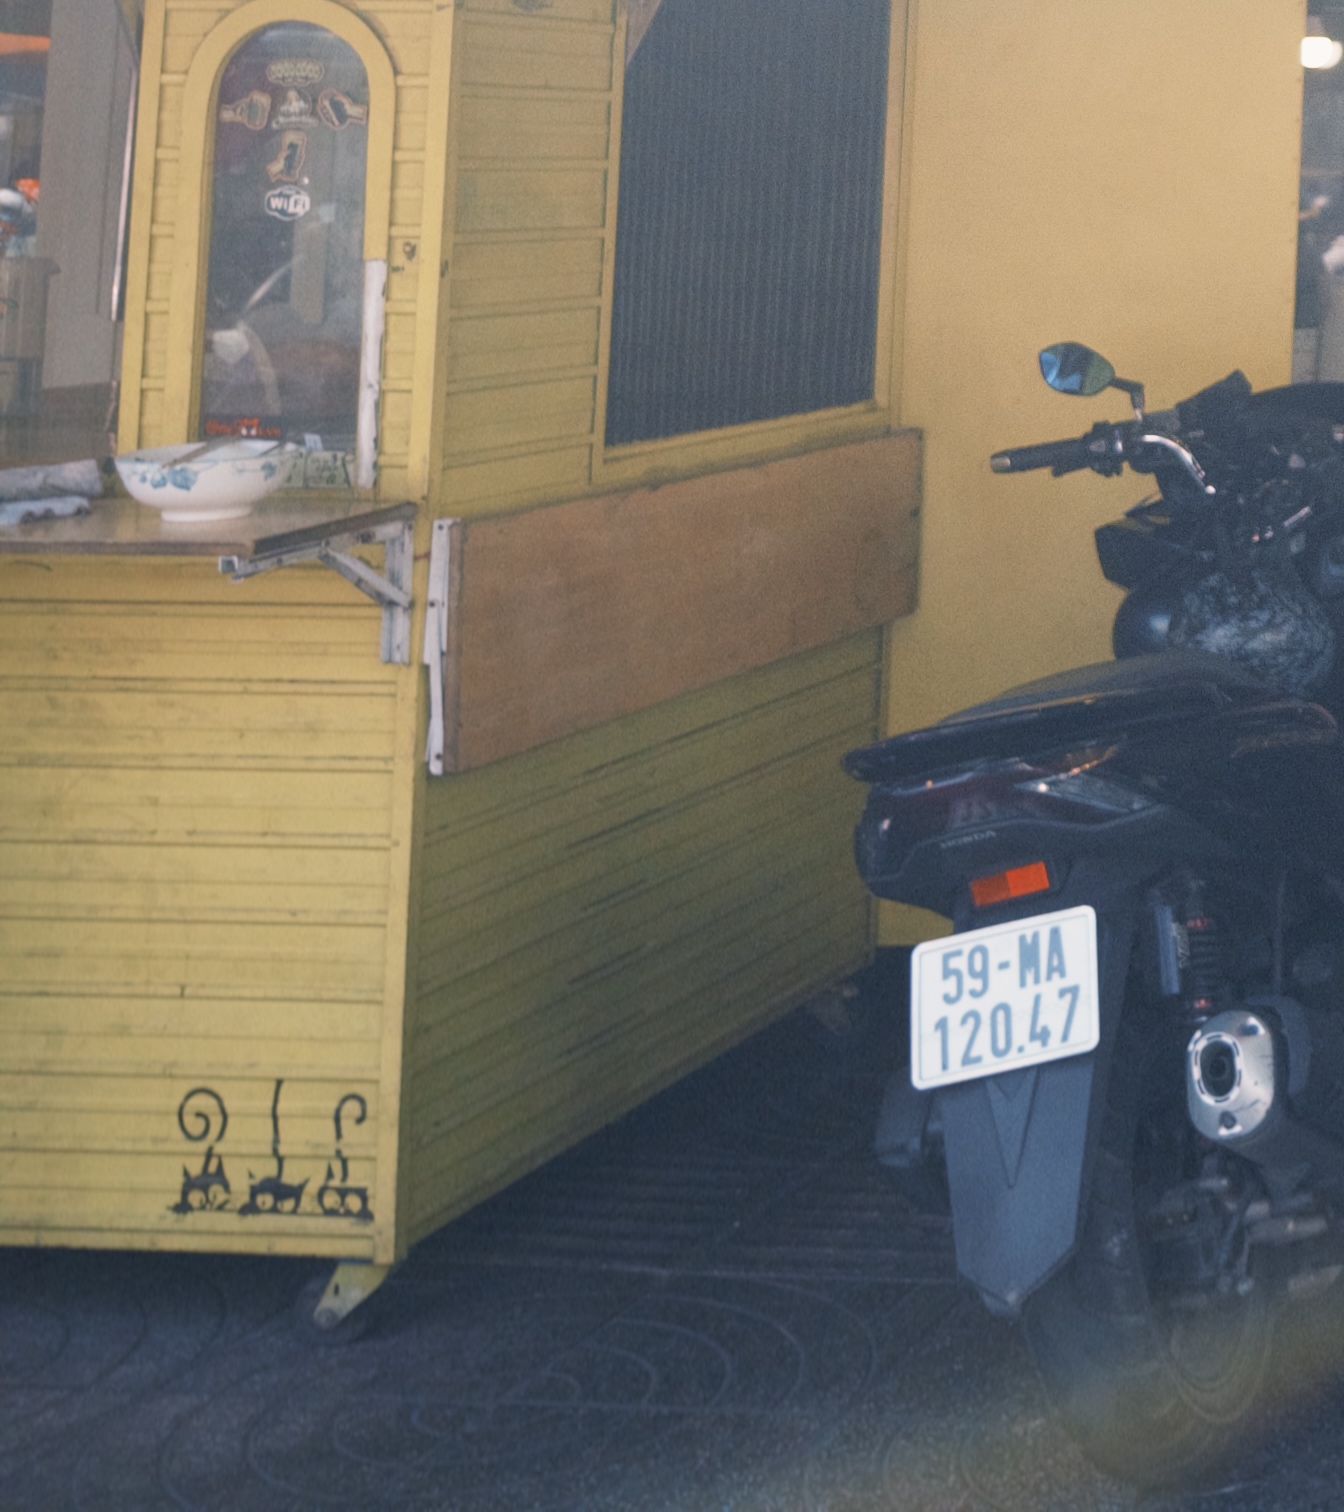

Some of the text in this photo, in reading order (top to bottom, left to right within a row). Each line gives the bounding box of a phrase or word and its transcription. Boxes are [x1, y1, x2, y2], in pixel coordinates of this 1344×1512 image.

[940, 829, 997, 849] HONDA
[941, 925, 1067, 1005] 59-MA
[934, 984, 1081, 1072] 120.47
